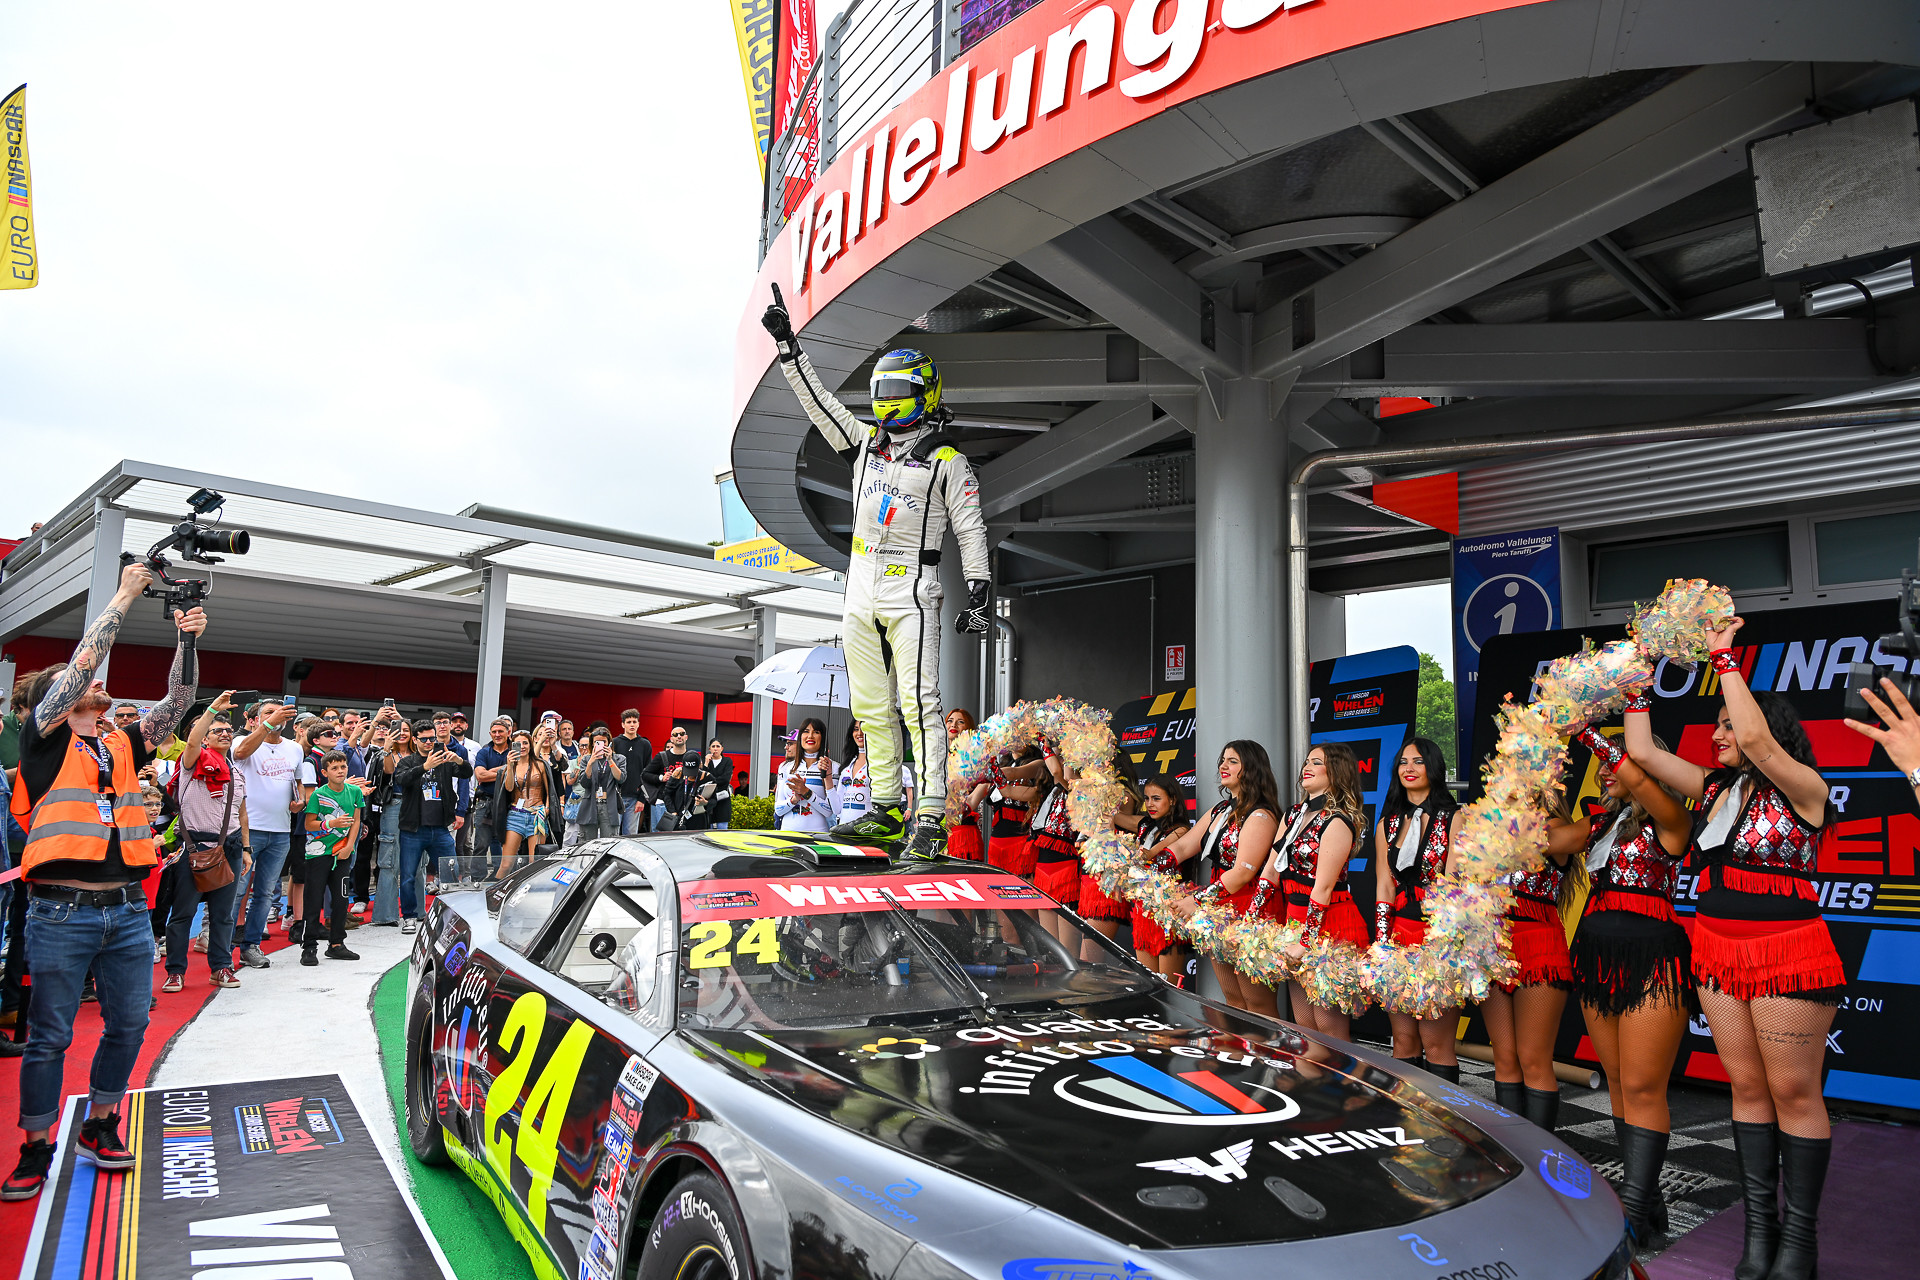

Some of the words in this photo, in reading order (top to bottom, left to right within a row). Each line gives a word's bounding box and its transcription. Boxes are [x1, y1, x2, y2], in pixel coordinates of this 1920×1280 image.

[5, 104, 28, 189] NASCAR
[10, 215, 34, 281] EURO
[1459, 542, 1505, 554] Autodromo
[1507, 534, 1552, 548] Vallelunga
[1491, 551, 1509, 559] Piero
[1510, 548, 1532, 557] Taruffi
[884, 564, 908, 577] 24
[1333, 693, 1384, 712] WHELEN
[1122, 727, 1157, 741] WHELEN
[687, 893, 760, 905] WHELEN
[766, 878, 986, 907] WHELEN
[689, 918, 781, 970] 24
[1855, 997, 1884, 1013] ON
[625, 1073, 638, 1088] RACE
[636, 1080, 647, 1094] CAR
[634, 1060, 654, 1082] NASCAR
[959, 1040, 1257, 1096] infitto.eu
[163, 1090, 209, 1126] EURO
[306, 1114, 331, 1133] NASCAR
[484, 991, 597, 1240] 24
[612, 1090, 643, 1132] WHELEN
[263, 1096, 325, 1154] WHELEN
[1268, 1127, 1425, 1160] HEINZ
[163, 1142, 220, 1200] NASCAR
[692, 1196, 740, 1280] HOOSIER
